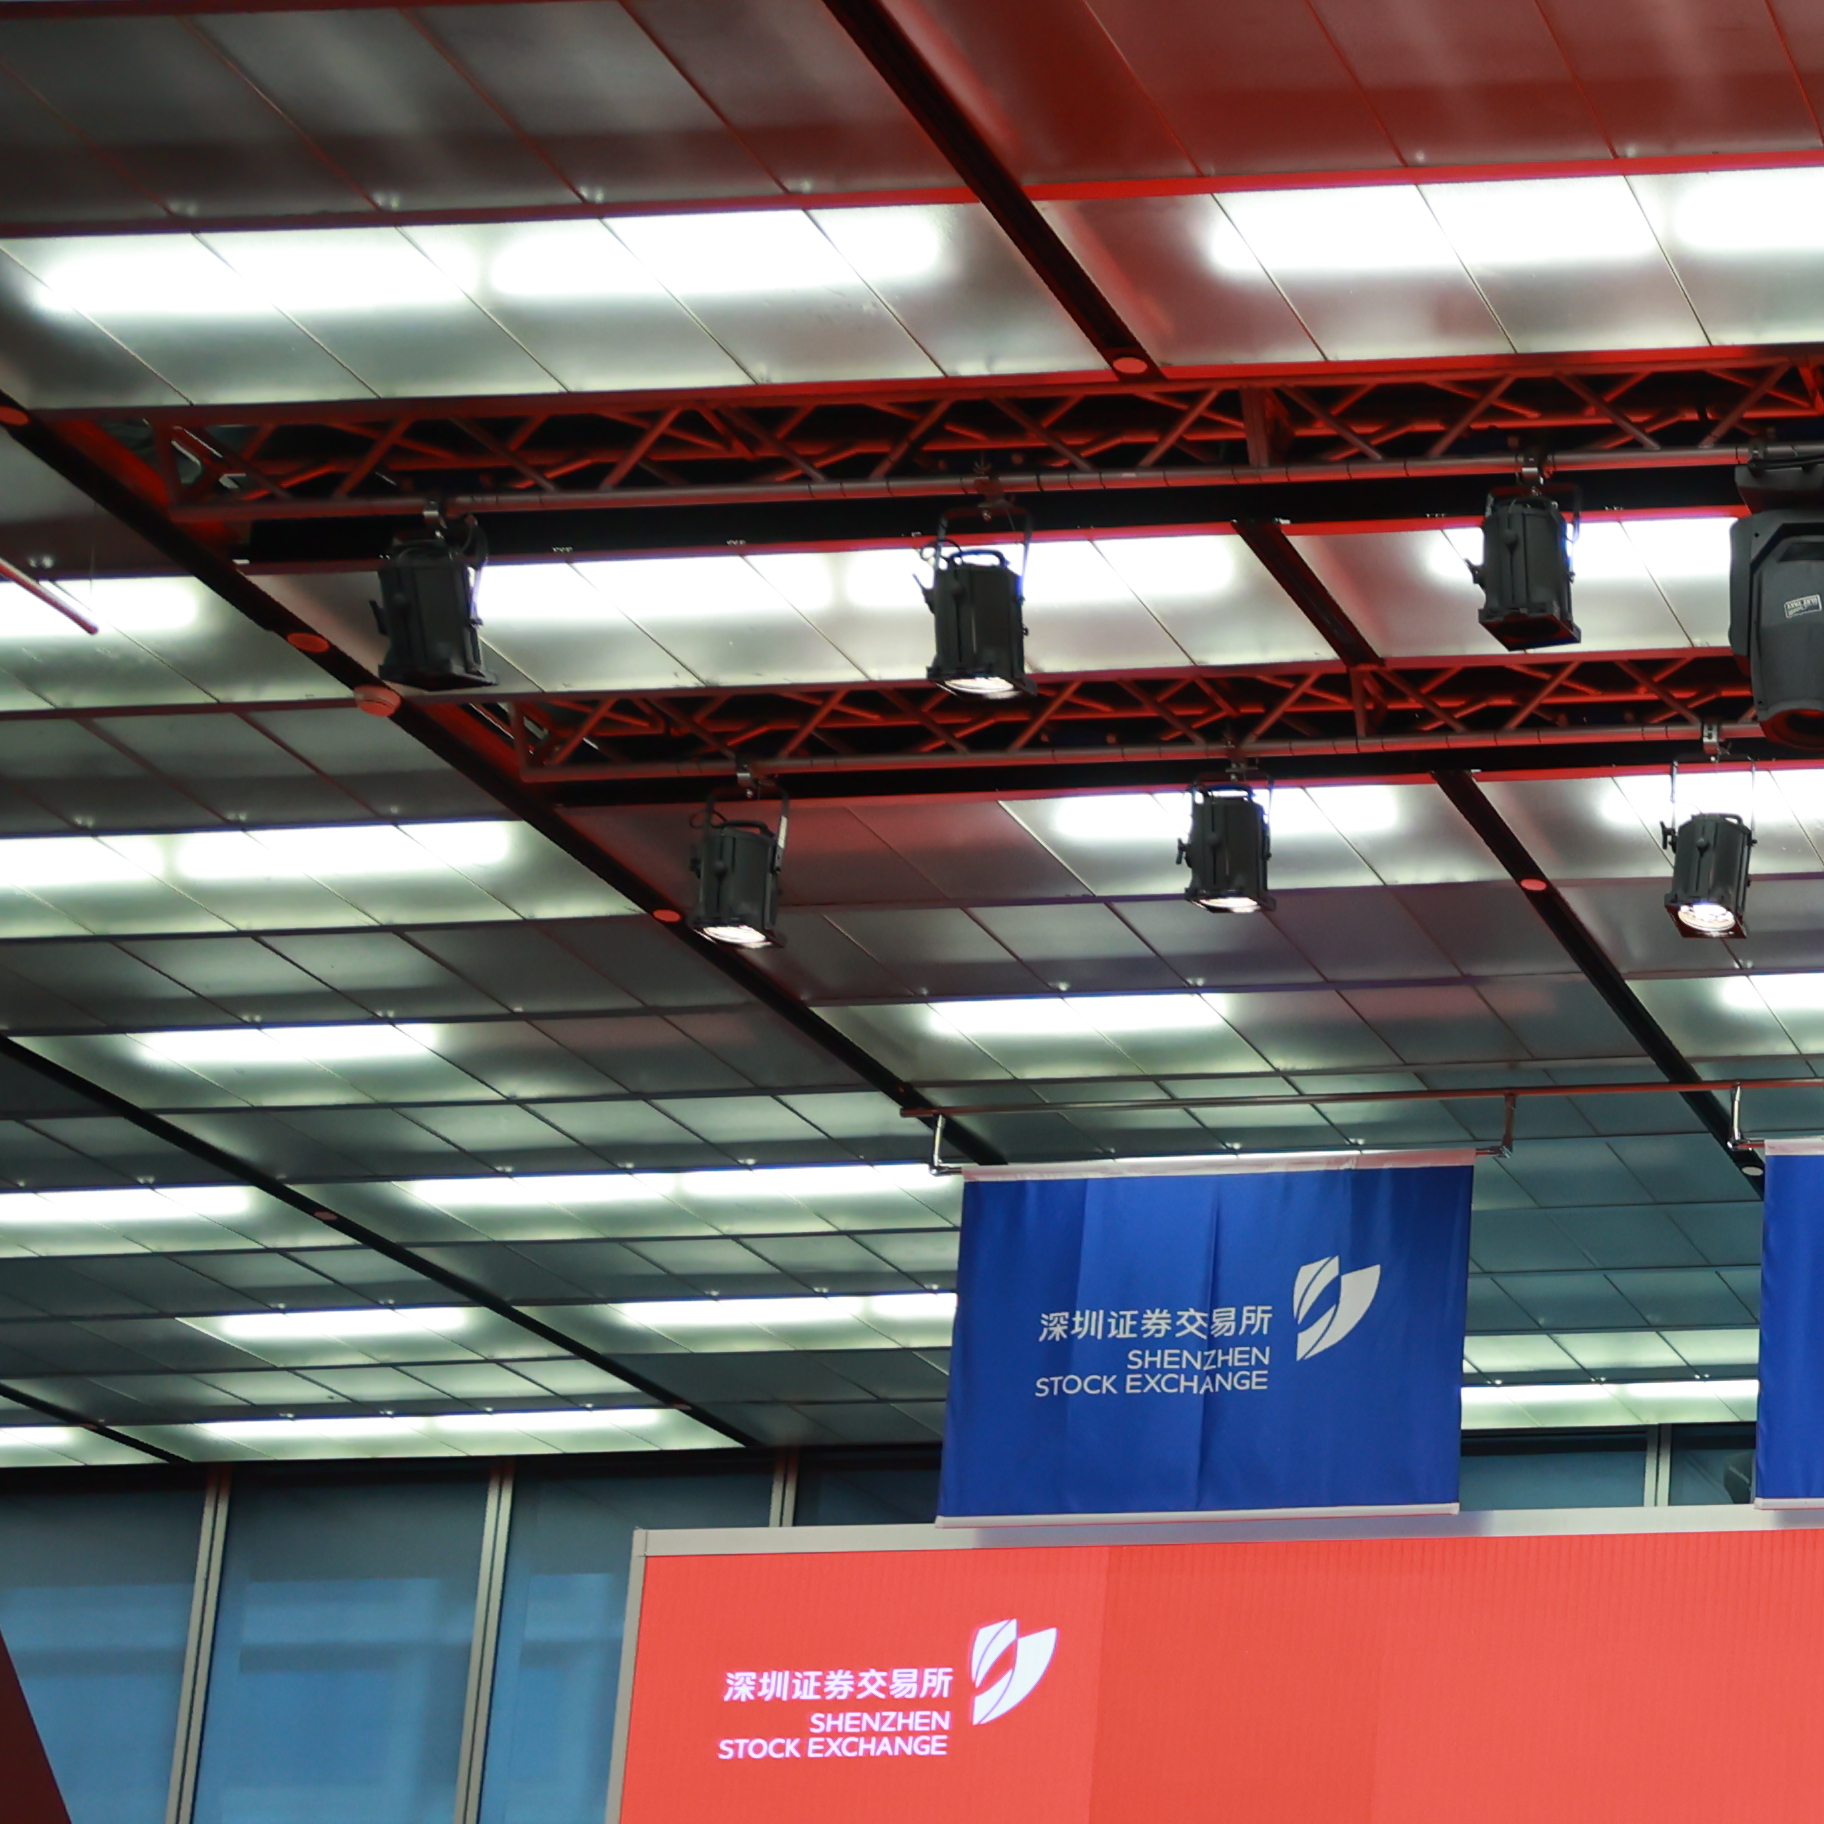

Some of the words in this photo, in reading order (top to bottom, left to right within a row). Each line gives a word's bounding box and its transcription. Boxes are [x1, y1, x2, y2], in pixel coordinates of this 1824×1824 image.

[1038, 1305, 1273, 1342] 深圳证券交易所
[1126, 1346, 1270, 1371] SHENZHEN
[1035, 1374, 1118, 1397] STOCK
[1125, 1370, 1269, 1395] EXCHANGE
[723, 1667, 954, 1702] 深圳证券交易所
[809, 1710, 951, 1733] SHENZHEN
[717, 1738, 801, 1760] STOCK
[807, 1735, 949, 1758] EXCHANGE
